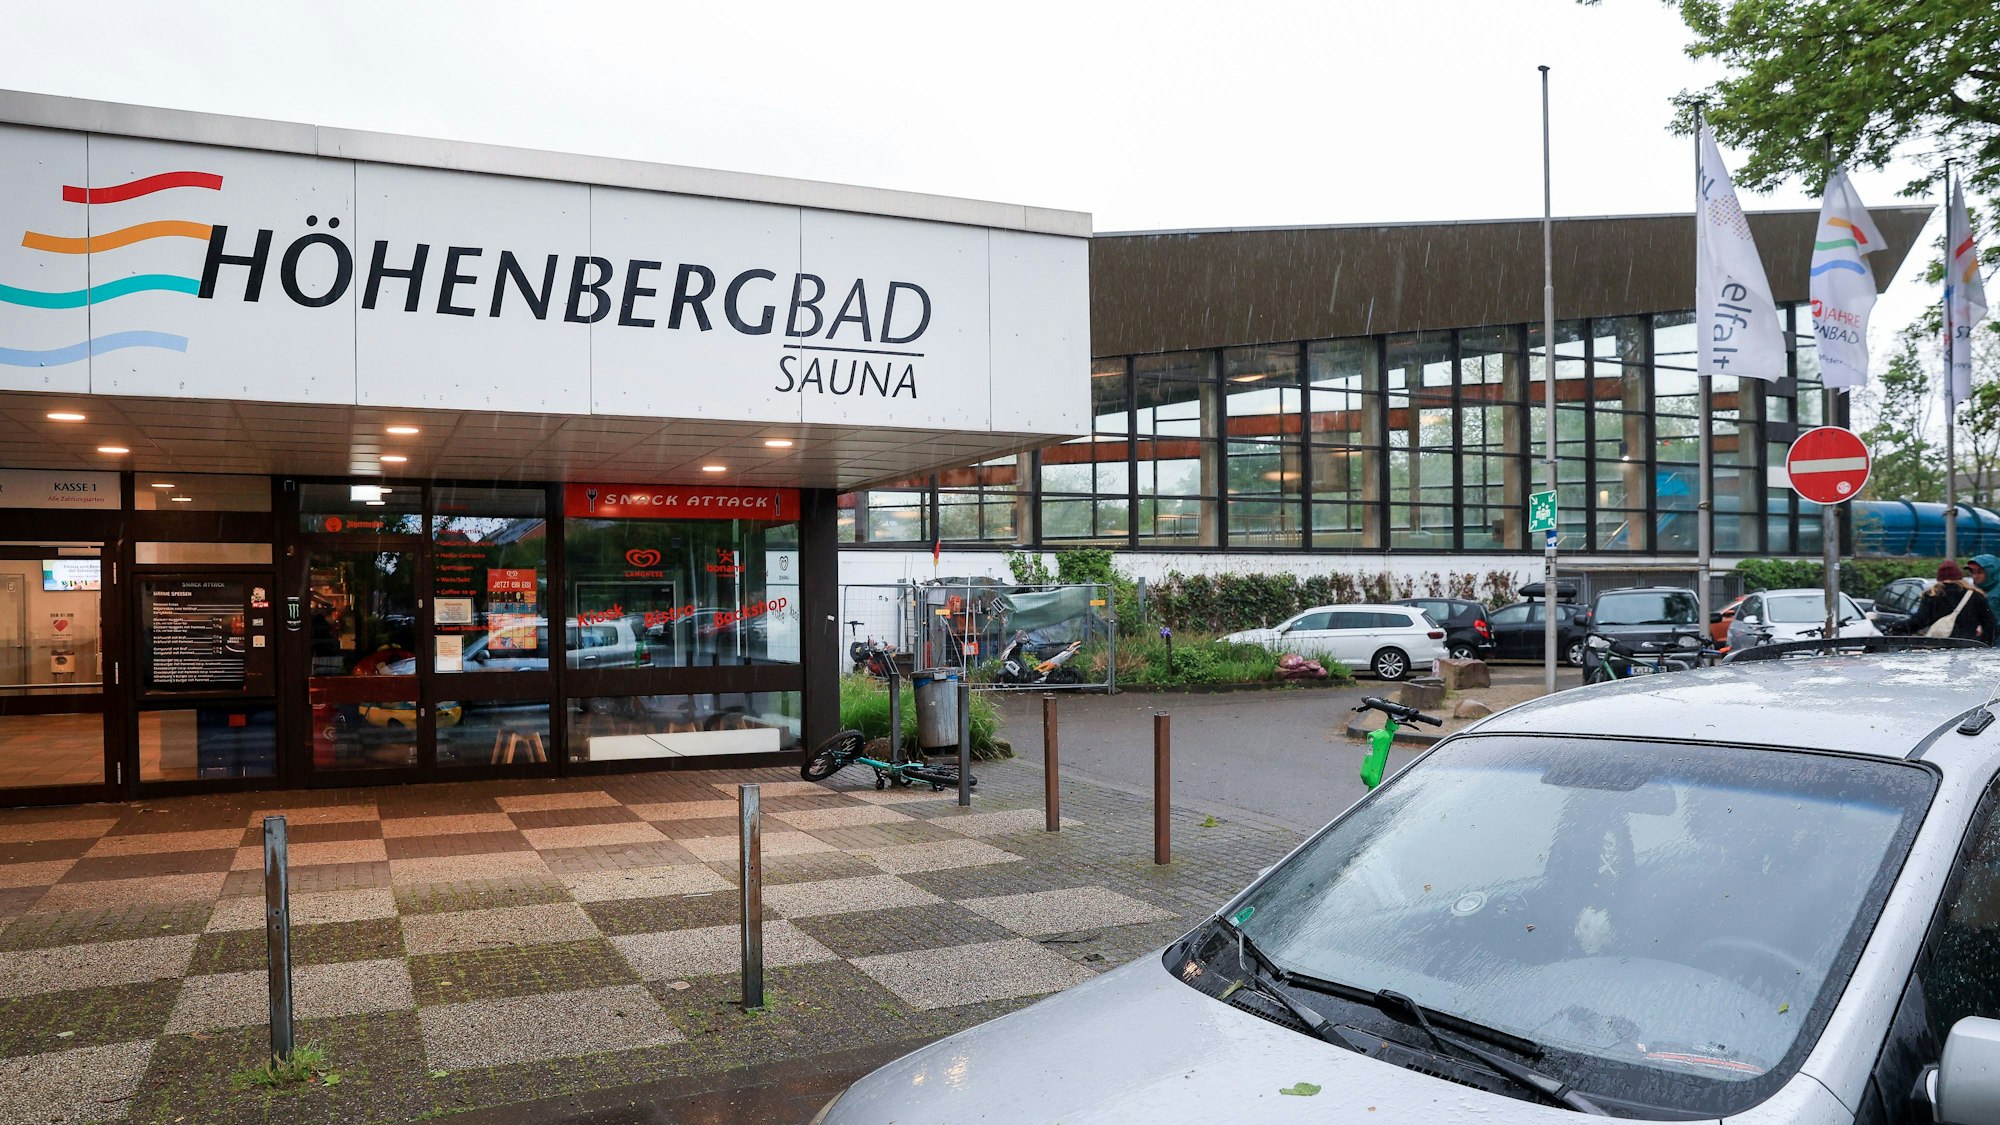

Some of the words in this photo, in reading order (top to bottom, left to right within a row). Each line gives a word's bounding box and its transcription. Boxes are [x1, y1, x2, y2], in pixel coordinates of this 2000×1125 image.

[197, 214, 932, 345] HÖHENBERGBAD
[1713, 275, 1753, 370] elfalt
[1824, 306, 1861, 329] JAHRE
[774, 355, 919, 399] SAUNA
[54, 482, 89, 492] KASSE
[92, 483, 97, 492] 1
[47, 495, 60, 503] Alle
[61, 496, 105, 504] Zahlungsarten
[604, 493, 679, 507] SNACK
[686, 495, 769, 508] ATTACK
[706, 563, 746, 573] bonami
[577, 603, 624, 628] Kiosk
[644, 604, 696, 628] Bistro
[713, 597, 788, 628] Backshop
